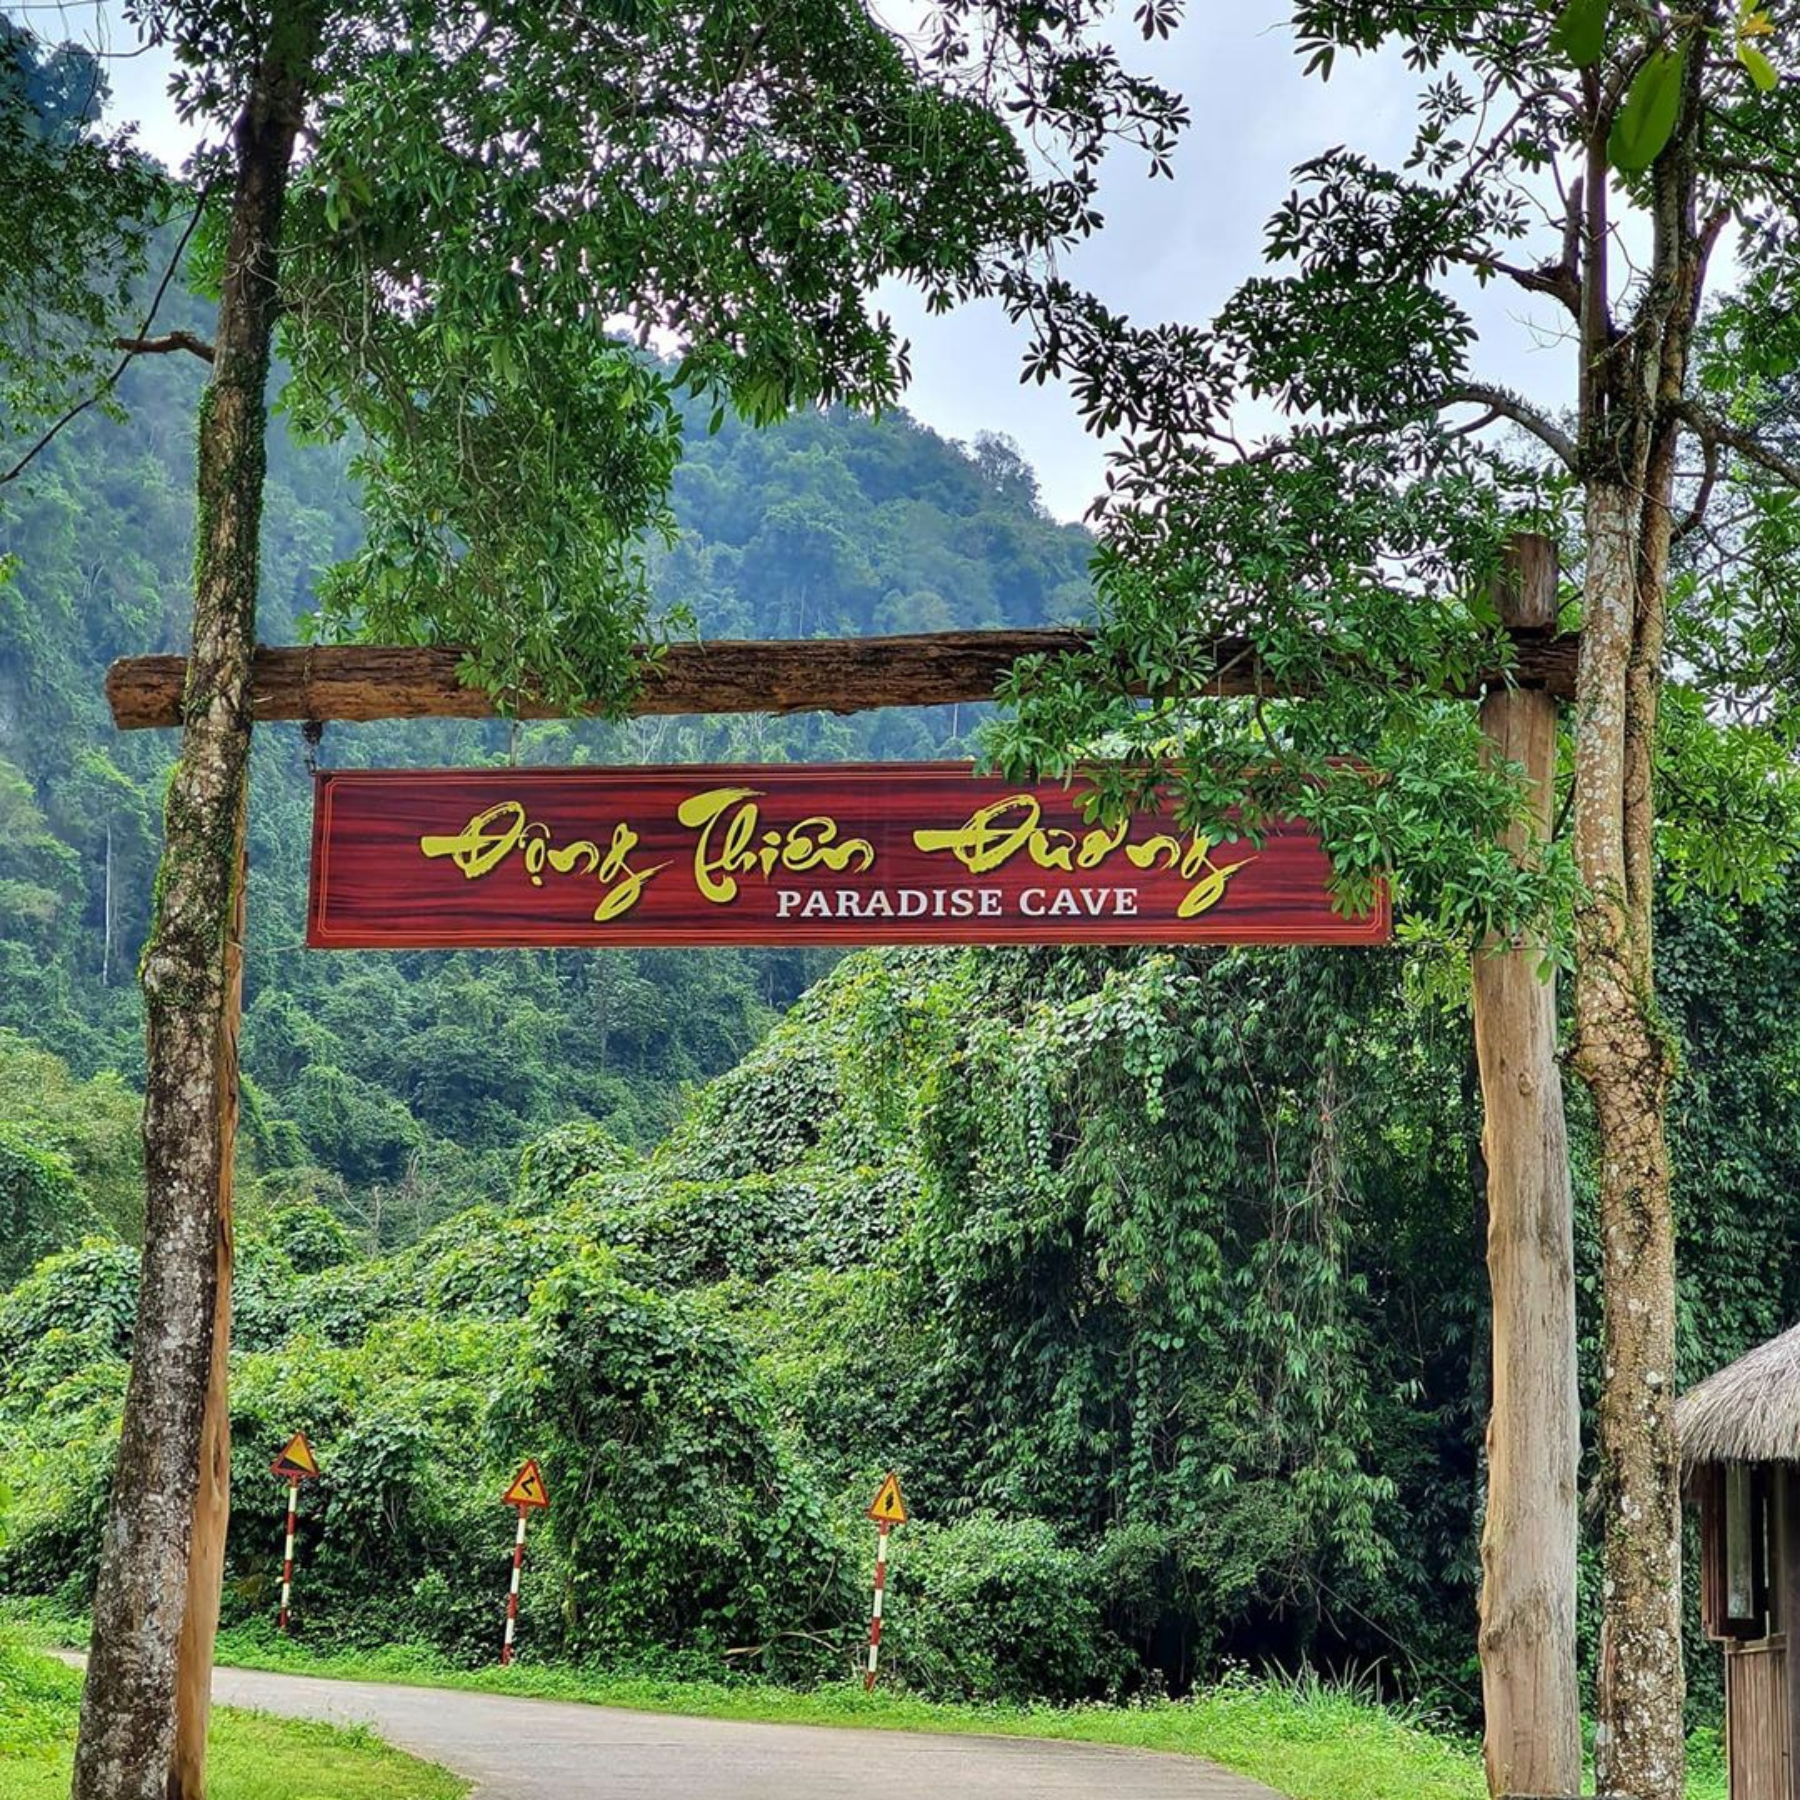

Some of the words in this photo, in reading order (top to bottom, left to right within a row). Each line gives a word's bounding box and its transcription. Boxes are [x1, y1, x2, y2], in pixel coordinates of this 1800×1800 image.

[421, 801, 673, 921] Động
[678, 787, 875, 903] Thiên
[776, 888, 1004, 918] PARADISE
[1018, 887, 1138, 916] CAVE
